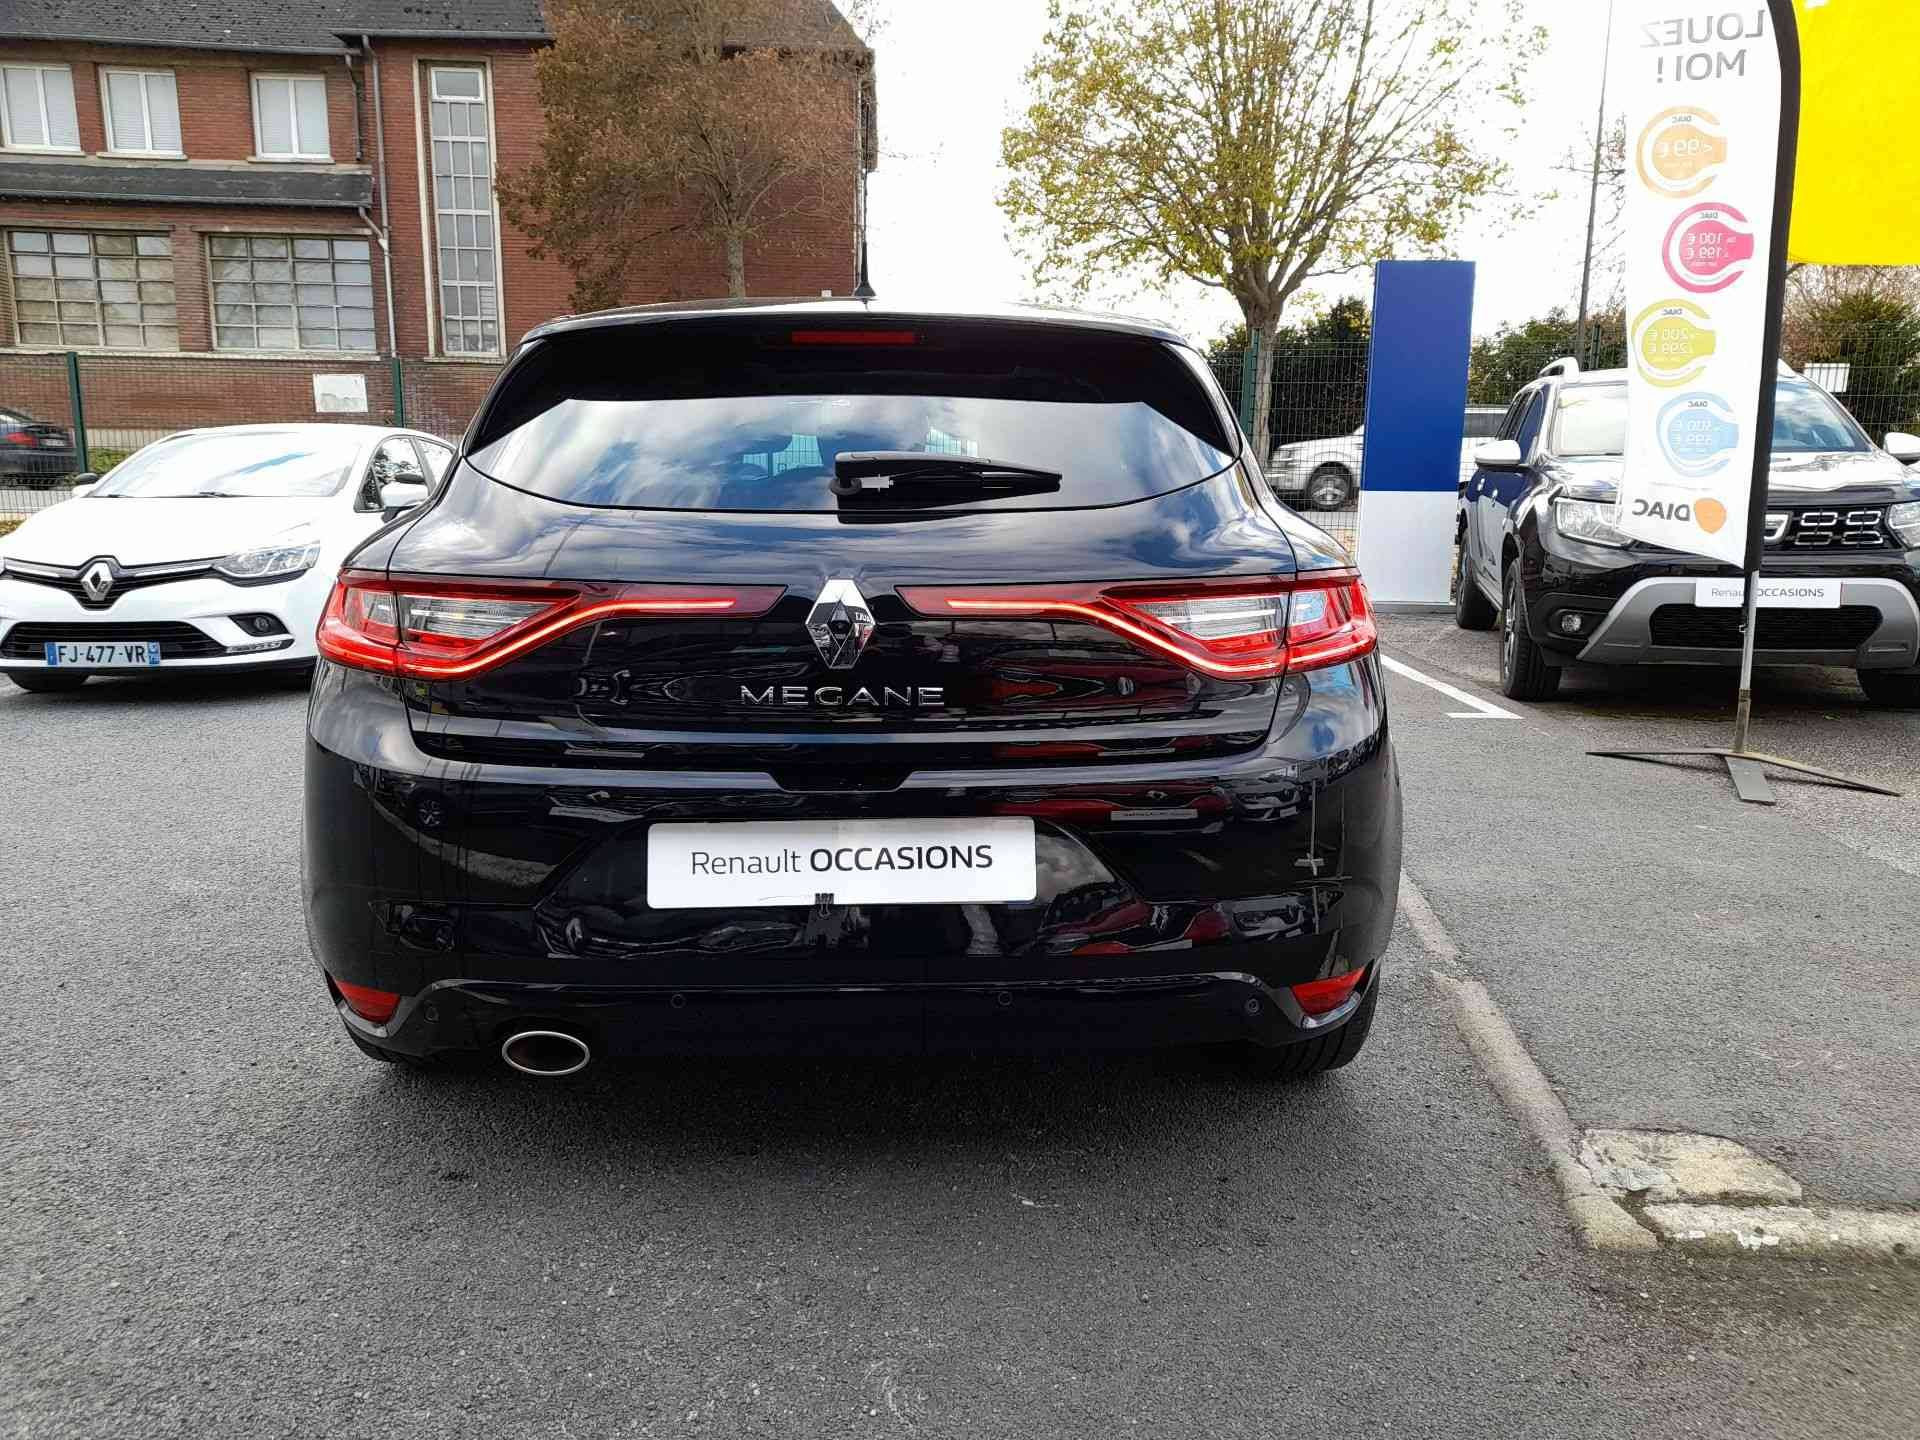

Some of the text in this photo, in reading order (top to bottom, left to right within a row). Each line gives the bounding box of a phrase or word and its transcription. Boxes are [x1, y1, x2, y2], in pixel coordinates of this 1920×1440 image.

[1711, 588, 1825, 598] Renau OCCASIONS
[57, 645, 147, 663] FJ-477-VR
[740, 685, 945, 706] MEGANE
[691, 845, 993, 875] Renault OCCASIONS
